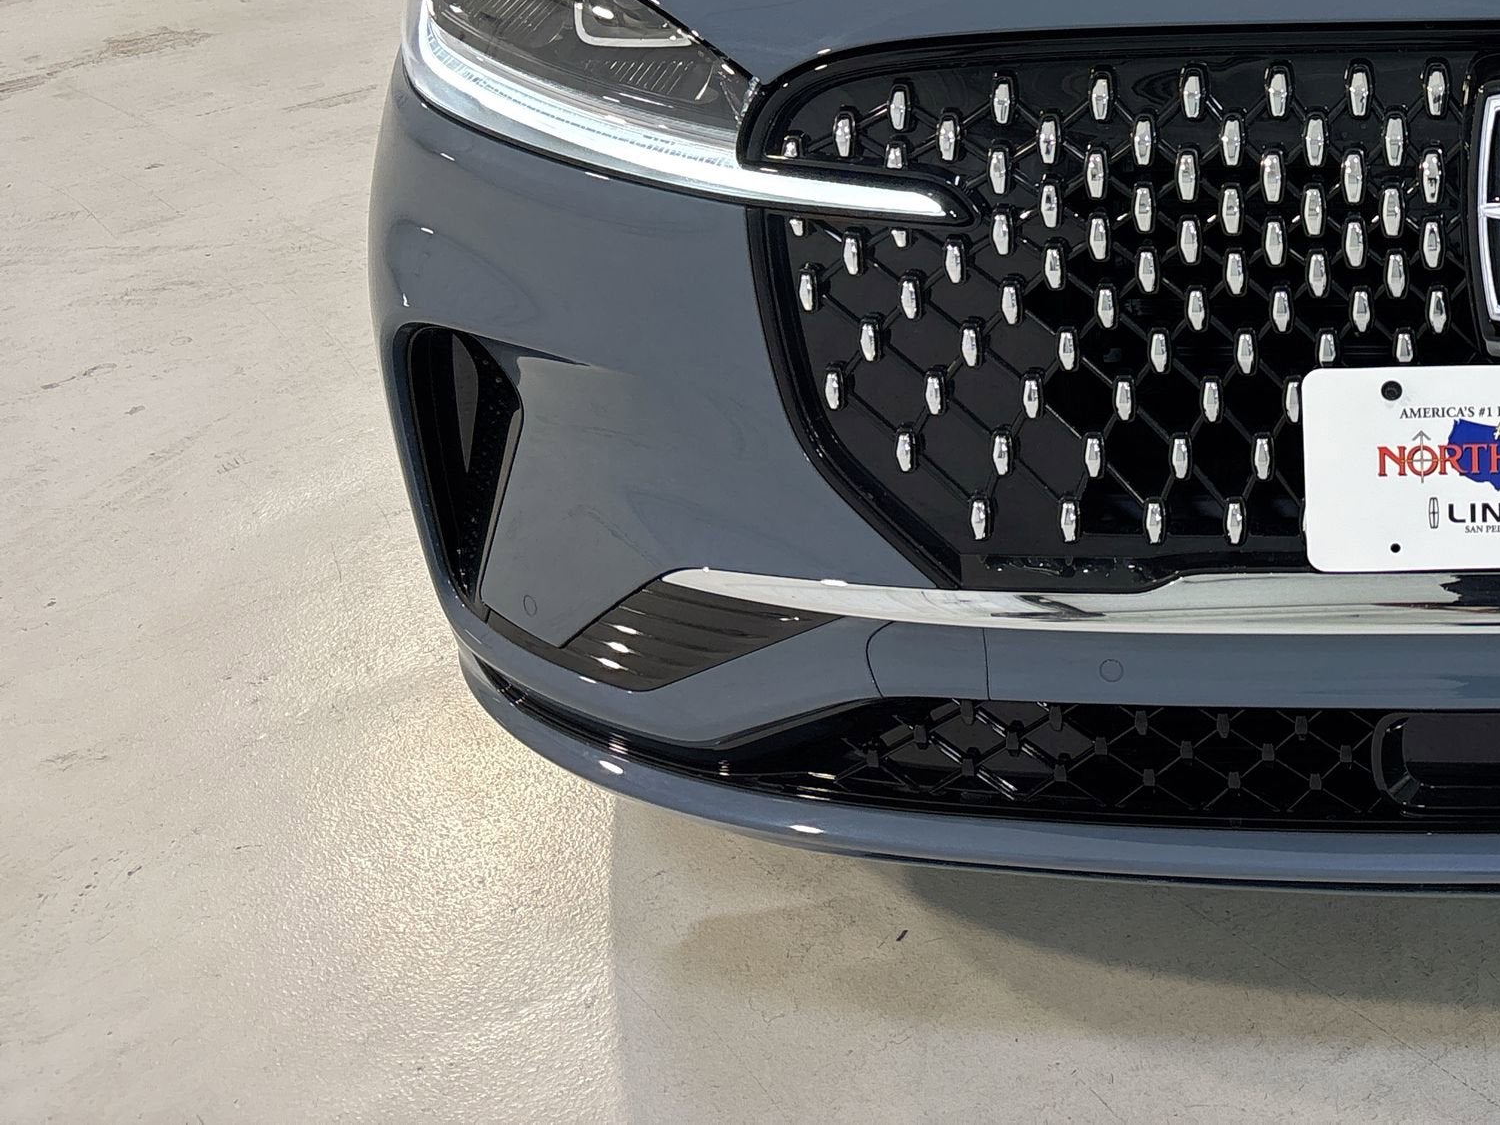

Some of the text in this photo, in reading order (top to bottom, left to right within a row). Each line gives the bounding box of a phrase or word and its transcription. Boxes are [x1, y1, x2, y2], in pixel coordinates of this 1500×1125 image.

[1400, 405, 1475, 419] AMERICA'S
[1478, 405, 1493, 418] #1
[1464, 524, 1483, 533] SAN
